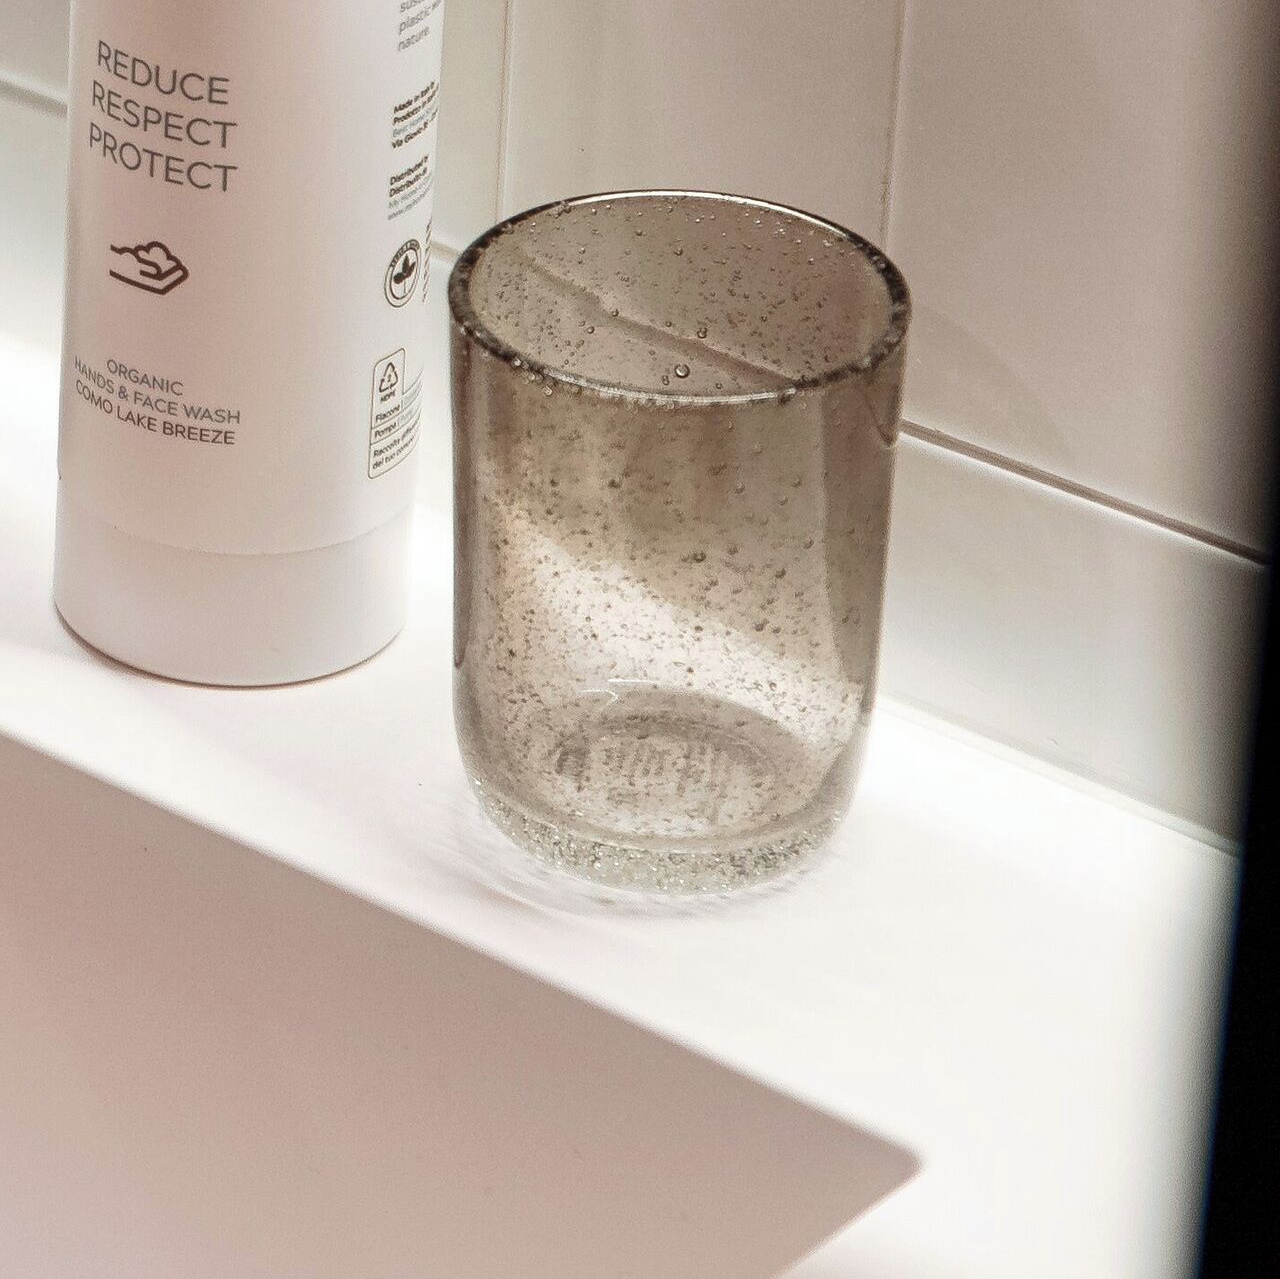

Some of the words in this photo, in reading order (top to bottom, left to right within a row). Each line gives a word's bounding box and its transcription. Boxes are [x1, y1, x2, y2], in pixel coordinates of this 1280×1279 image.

[98, 40, 230, 104] REDUCE
[93, 80, 237, 148] RESPECT
[90, 122, 238, 192] PROTECT
[74, 355, 115, 395] HANDS
[118, 385, 129, 401] &
[134, 391, 178, 416] FACE
[182, 403, 240, 424] WASH
[107, 359, 184, 396] ORGANIC
[76, 379, 113, 414] COMO
[117, 405, 157, 432] LAKE
[162, 421, 235, 445] BREEZE
